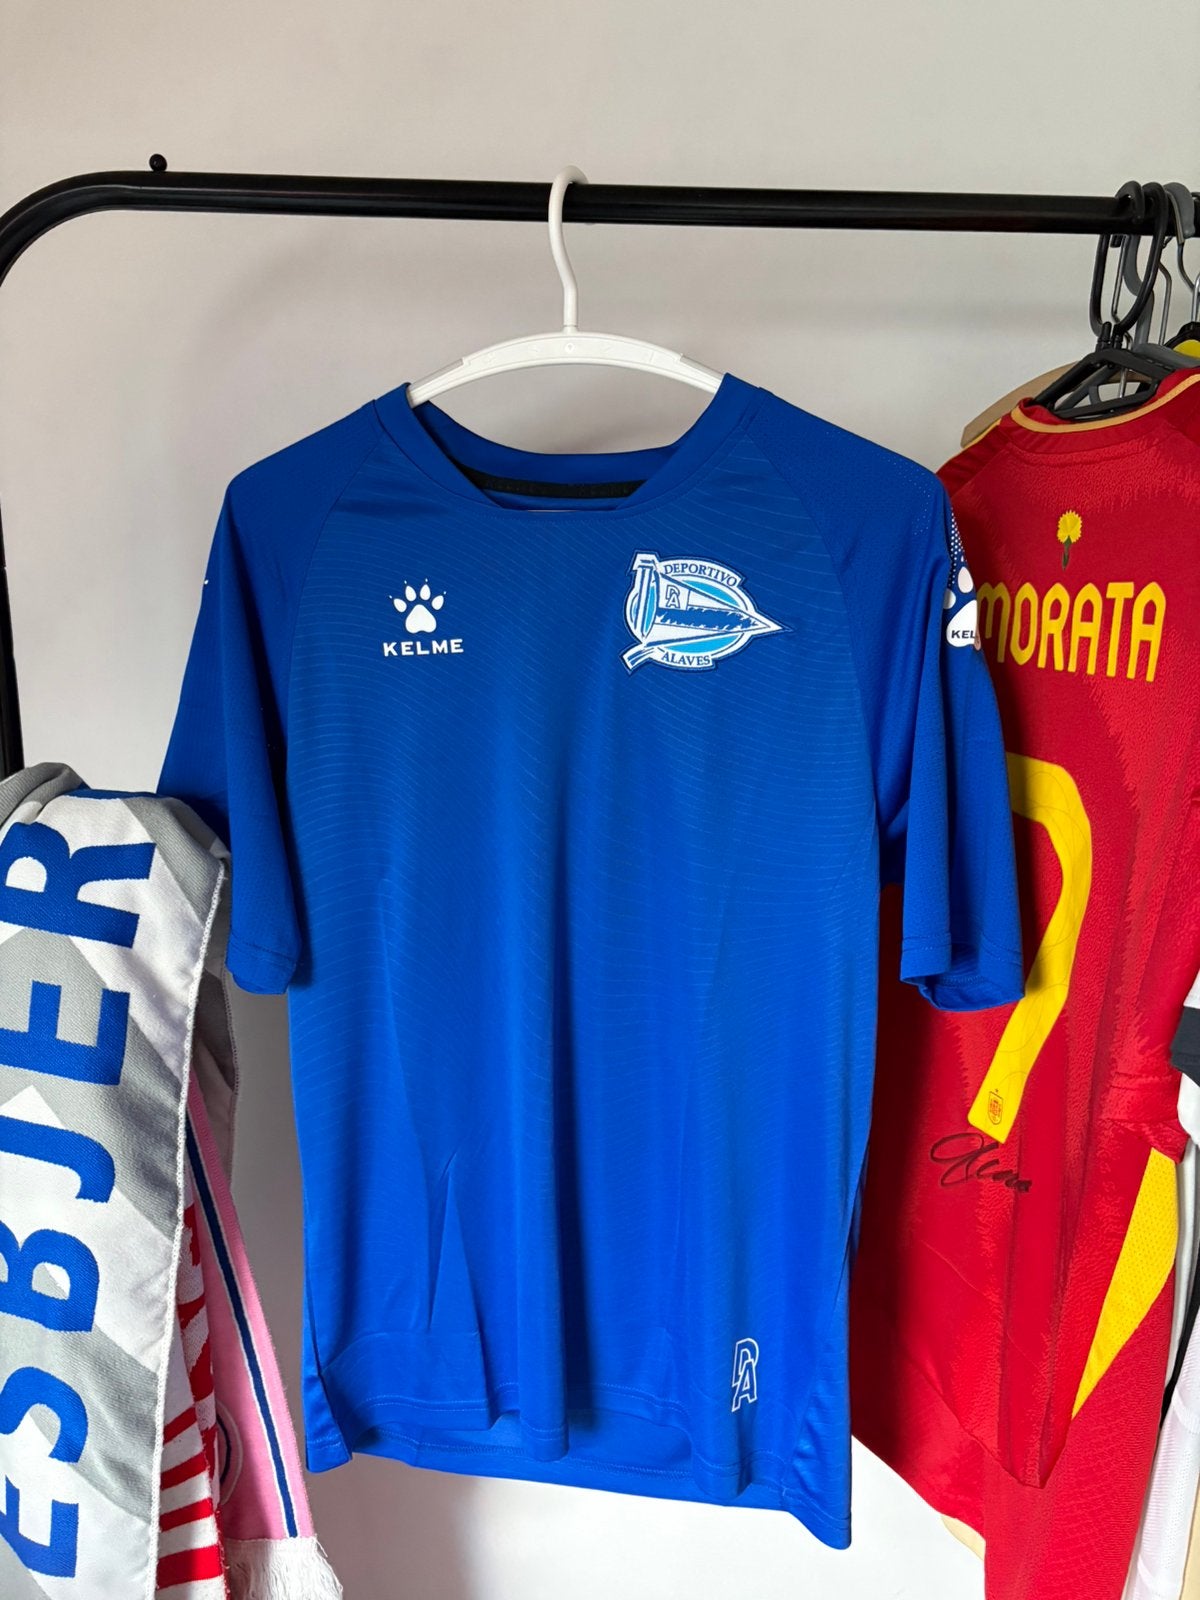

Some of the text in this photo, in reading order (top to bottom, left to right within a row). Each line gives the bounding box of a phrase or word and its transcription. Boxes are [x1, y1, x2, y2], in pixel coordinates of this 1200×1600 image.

[663, 563, 738, 587] DEPORTIVO
[951, 629, 976, 639] KEL
[976, 582, 1167, 683] MORATA
[383, 638, 464, 657] KELME
[661, 651, 711, 666] ALAVES
[0, 789, 157, 1578] ESBJER
